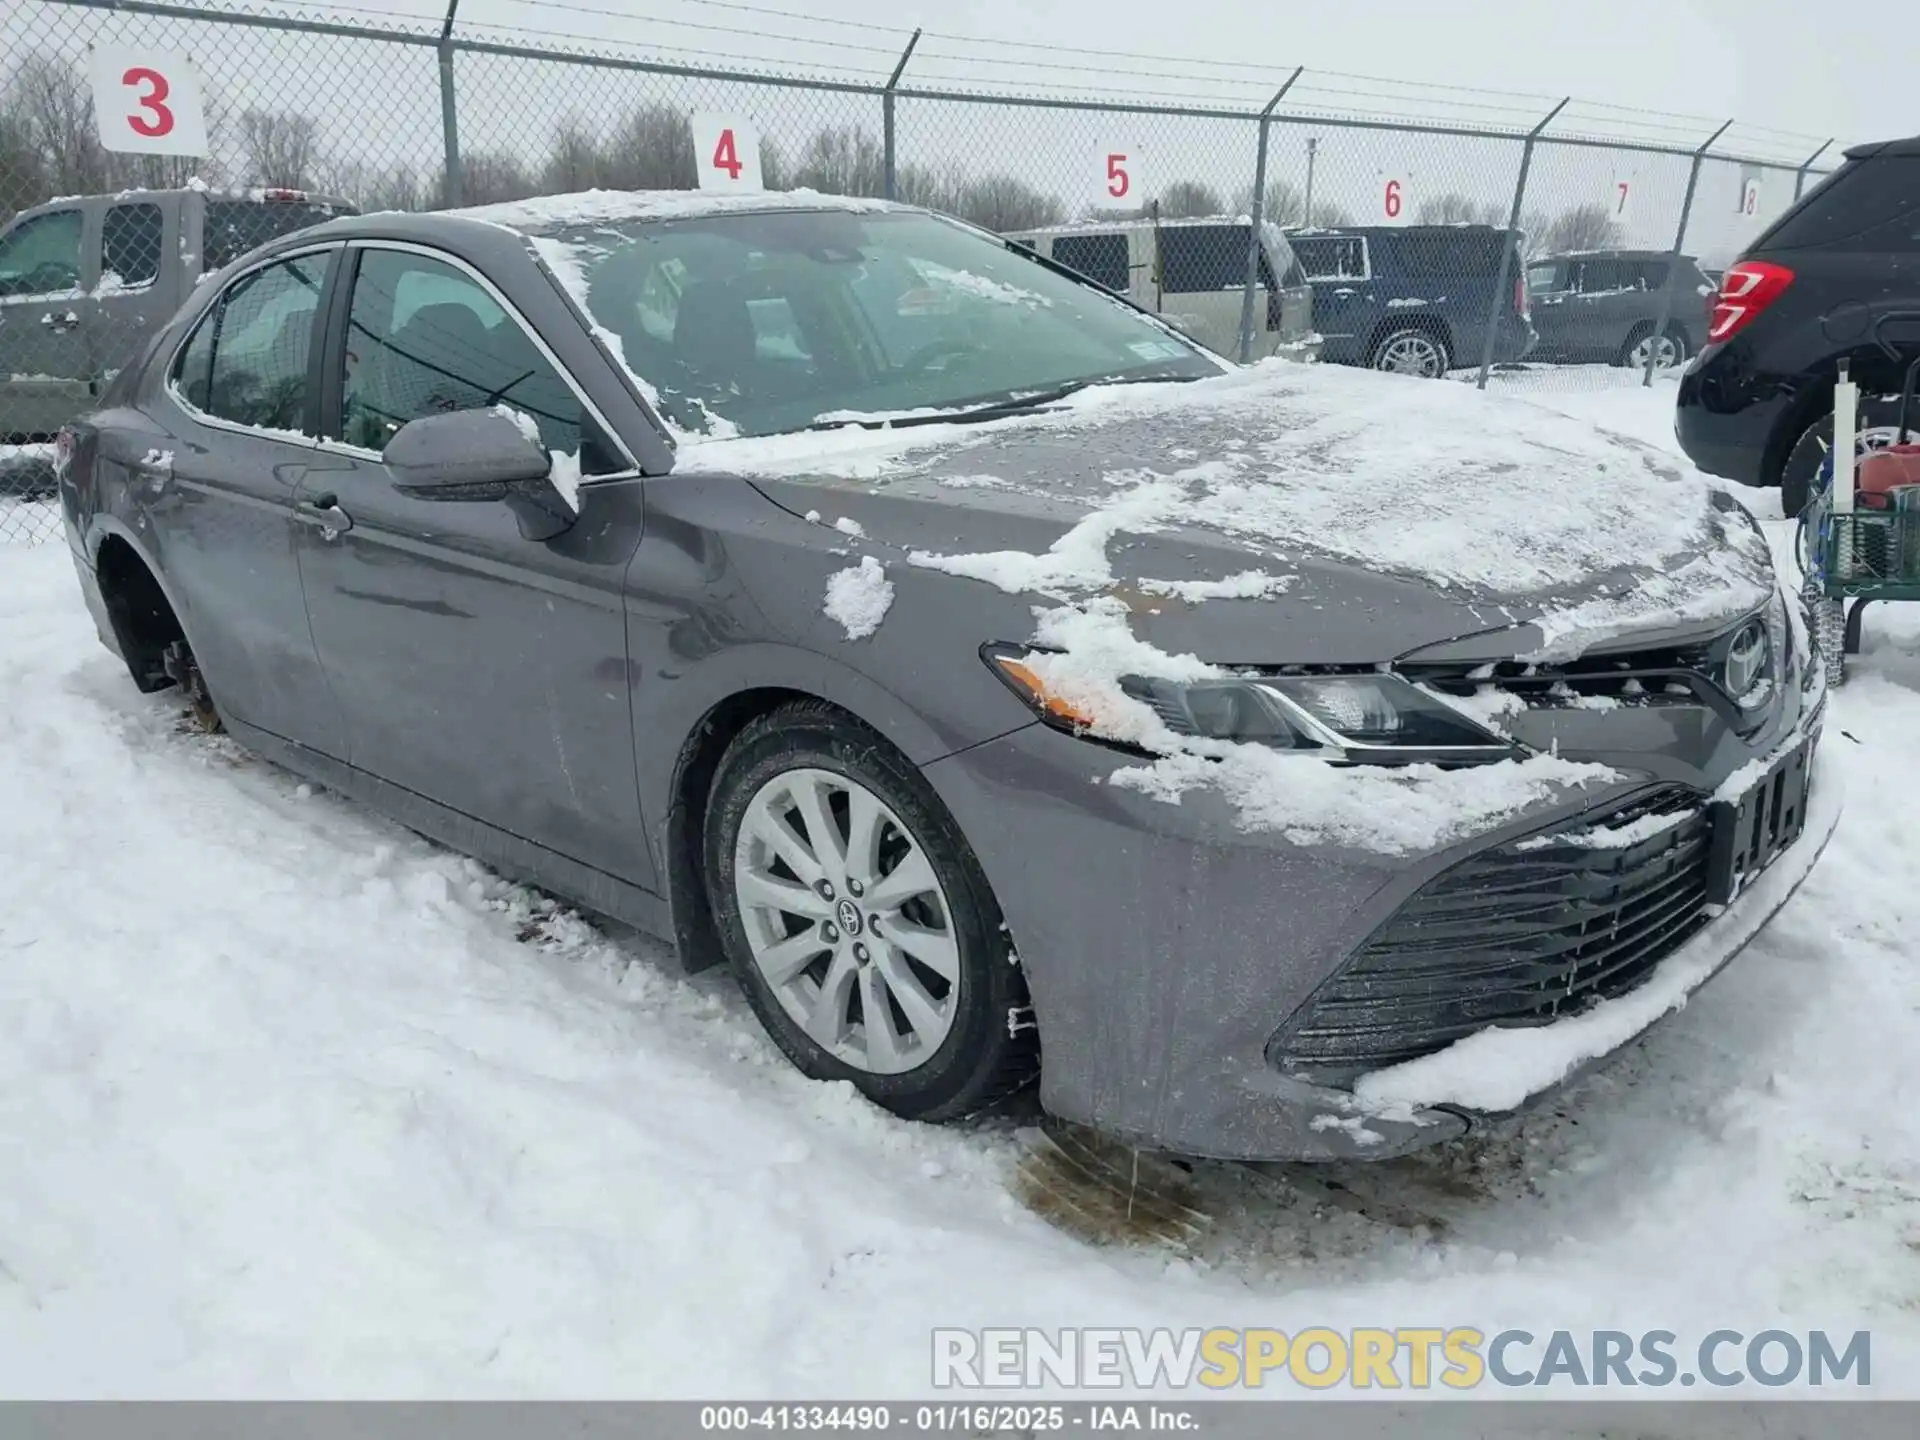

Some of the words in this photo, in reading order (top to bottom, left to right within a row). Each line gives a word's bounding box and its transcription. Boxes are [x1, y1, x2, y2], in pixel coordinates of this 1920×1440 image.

[122, 67, 174, 136] 3
[713, 129, 742, 178] 4
[1107, 154, 1128, 197] 5
[1385, 181, 1400, 217] 6
[1618, 184, 1628, 213] 7
[1747, 188, 1756, 214] 8
